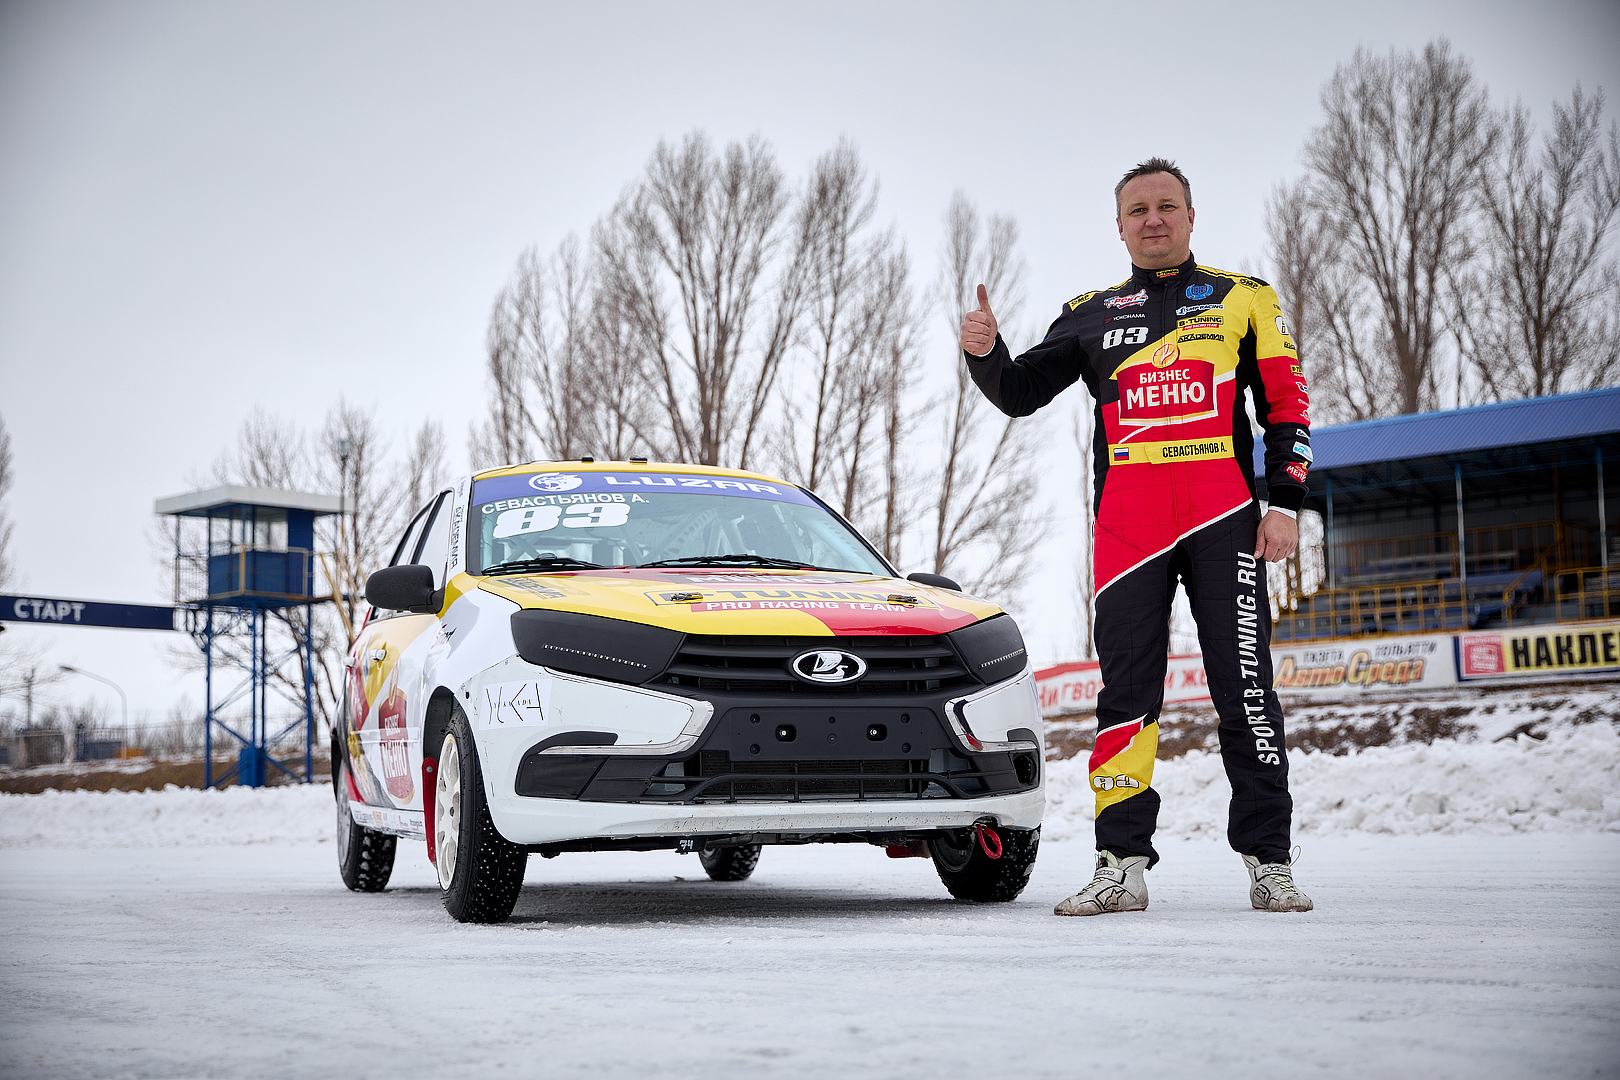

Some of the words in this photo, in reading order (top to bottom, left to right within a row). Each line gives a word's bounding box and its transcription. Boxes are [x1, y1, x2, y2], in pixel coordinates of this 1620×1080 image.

[1113, 313, 1146, 321] YOKOHAMA
[1102, 326, 1149, 350] 83
[1177, 332, 1225, 344] АКАДЕМИЯ
[1139, 368, 1191, 384] БИЗНЕС
[1126, 381, 1206, 410] МЕНЮ
[1162, 443, 1219, 458] СЕВАСТЬЯНОВ
[1220, 441, 1228, 453] А.
[603, 476, 783, 496] LUZAR
[481, 493, 627, 515] СЕВАСТЬЯНОВ
[631, 493, 651, 504] А.
[492, 502, 632, 539] 83
[13, 598, 86, 622] СТАРТ
[706, 601, 752, 611] PRO
[759, 601, 840, 610] RACING
[844, 602, 906, 613] TEAM
[1236, 551, 1281, 767] SPORT.B-TUNING.RU
[1303, 650, 1345, 662] ГАЗЕТА
[1375, 642, 1438, 657] ТОЛЬЯТТИ
[1512, 632, 1620, 668] НАКЛЕ
[381, 738, 408, 778] МЕНЮ
